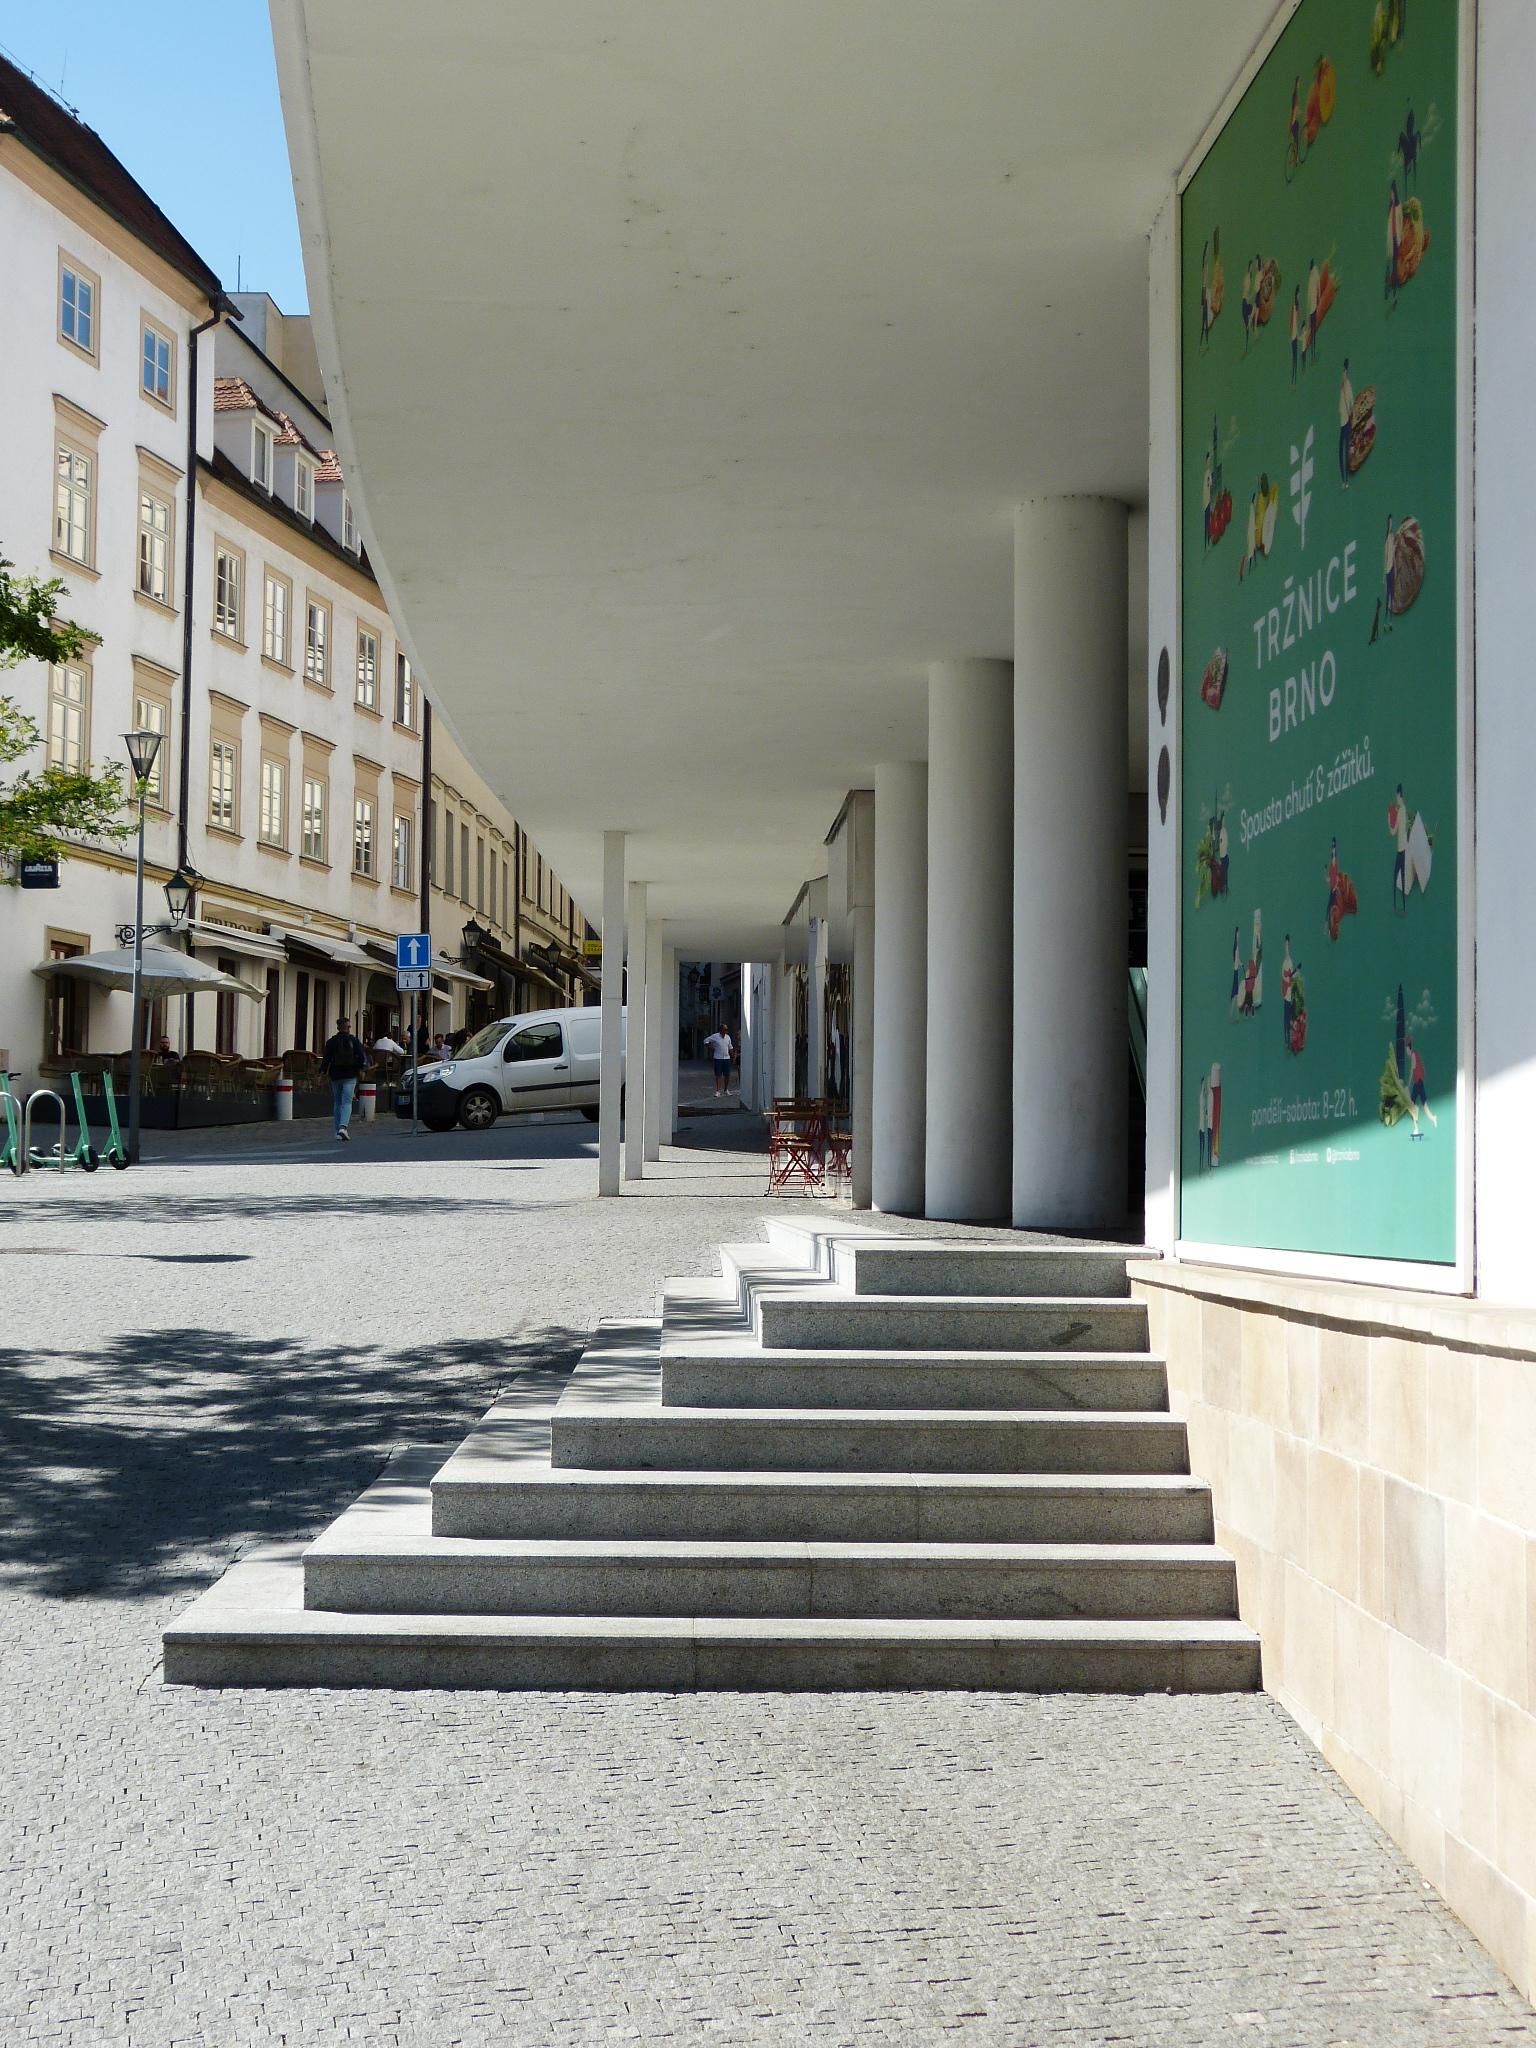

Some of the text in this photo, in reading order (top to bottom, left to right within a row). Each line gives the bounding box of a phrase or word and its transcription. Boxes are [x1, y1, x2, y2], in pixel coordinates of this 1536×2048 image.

[1253, 540, 1357, 670] TRŽNICE
[1269, 650, 1336, 743] BRNO
[1240, 735, 1375, 852] Spousta chutí & zážitků.
